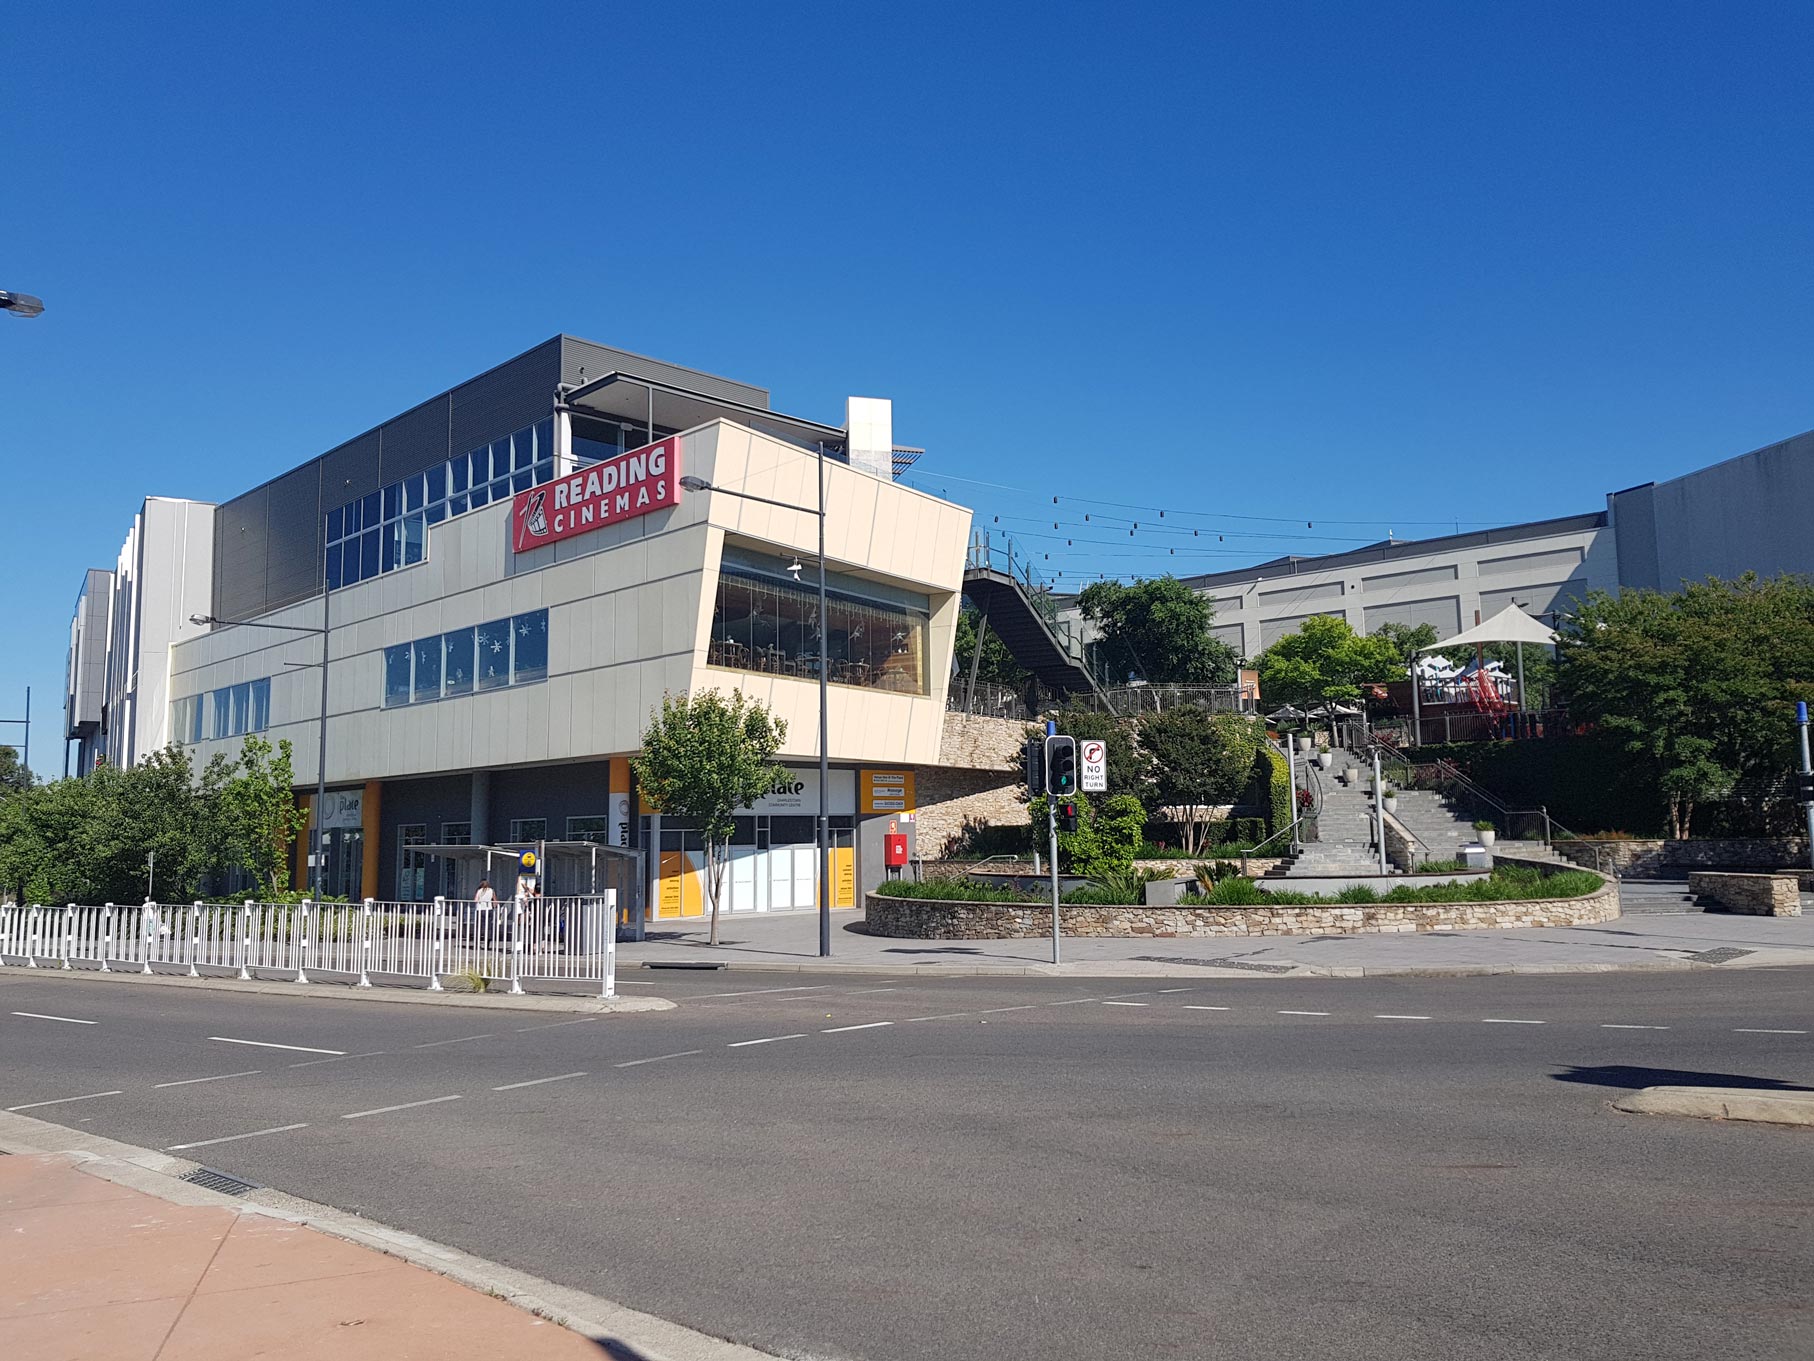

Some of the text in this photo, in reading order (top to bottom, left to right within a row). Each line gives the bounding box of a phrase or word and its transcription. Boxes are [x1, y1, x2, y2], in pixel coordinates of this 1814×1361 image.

[554, 446, 666, 511] READING
[554, 479, 666, 533] CINEMAS
[339, 796, 360, 815] place
